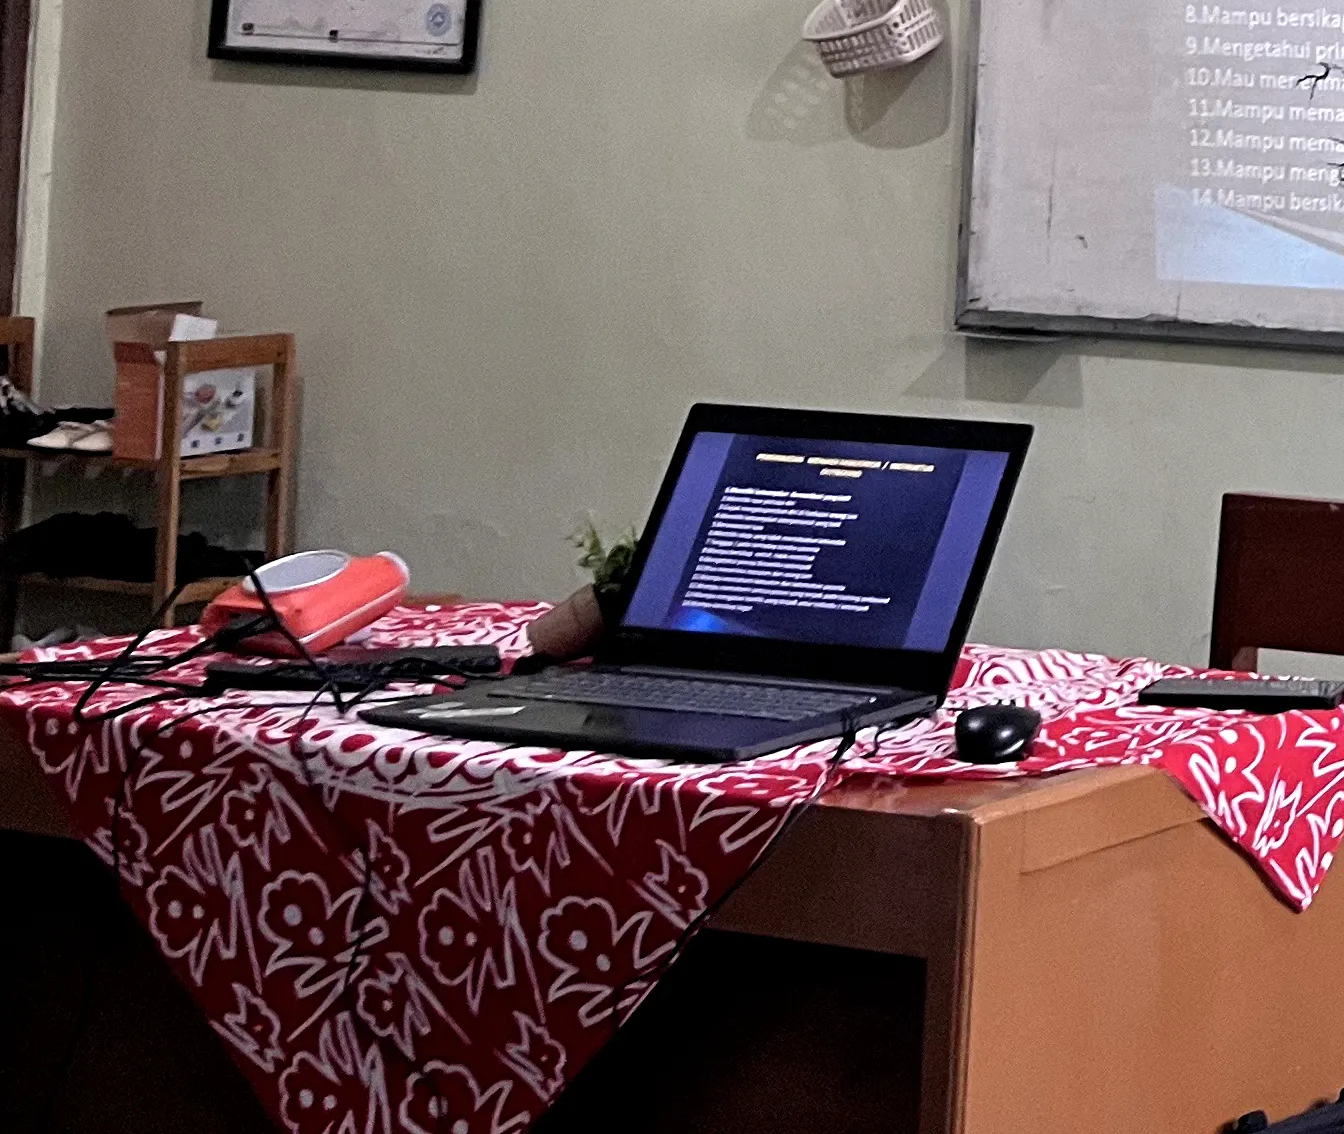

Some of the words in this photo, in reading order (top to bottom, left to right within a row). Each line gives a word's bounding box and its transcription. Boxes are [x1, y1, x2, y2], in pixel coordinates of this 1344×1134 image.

[1185, 3, 1273, 30] 8.Mampu
[1186, 35, 1311, 62] 9.Mengetahui
[1189, 98, 1284, 124] 11.Mampu
[1189, 128, 1284, 154] 12.Mampu
